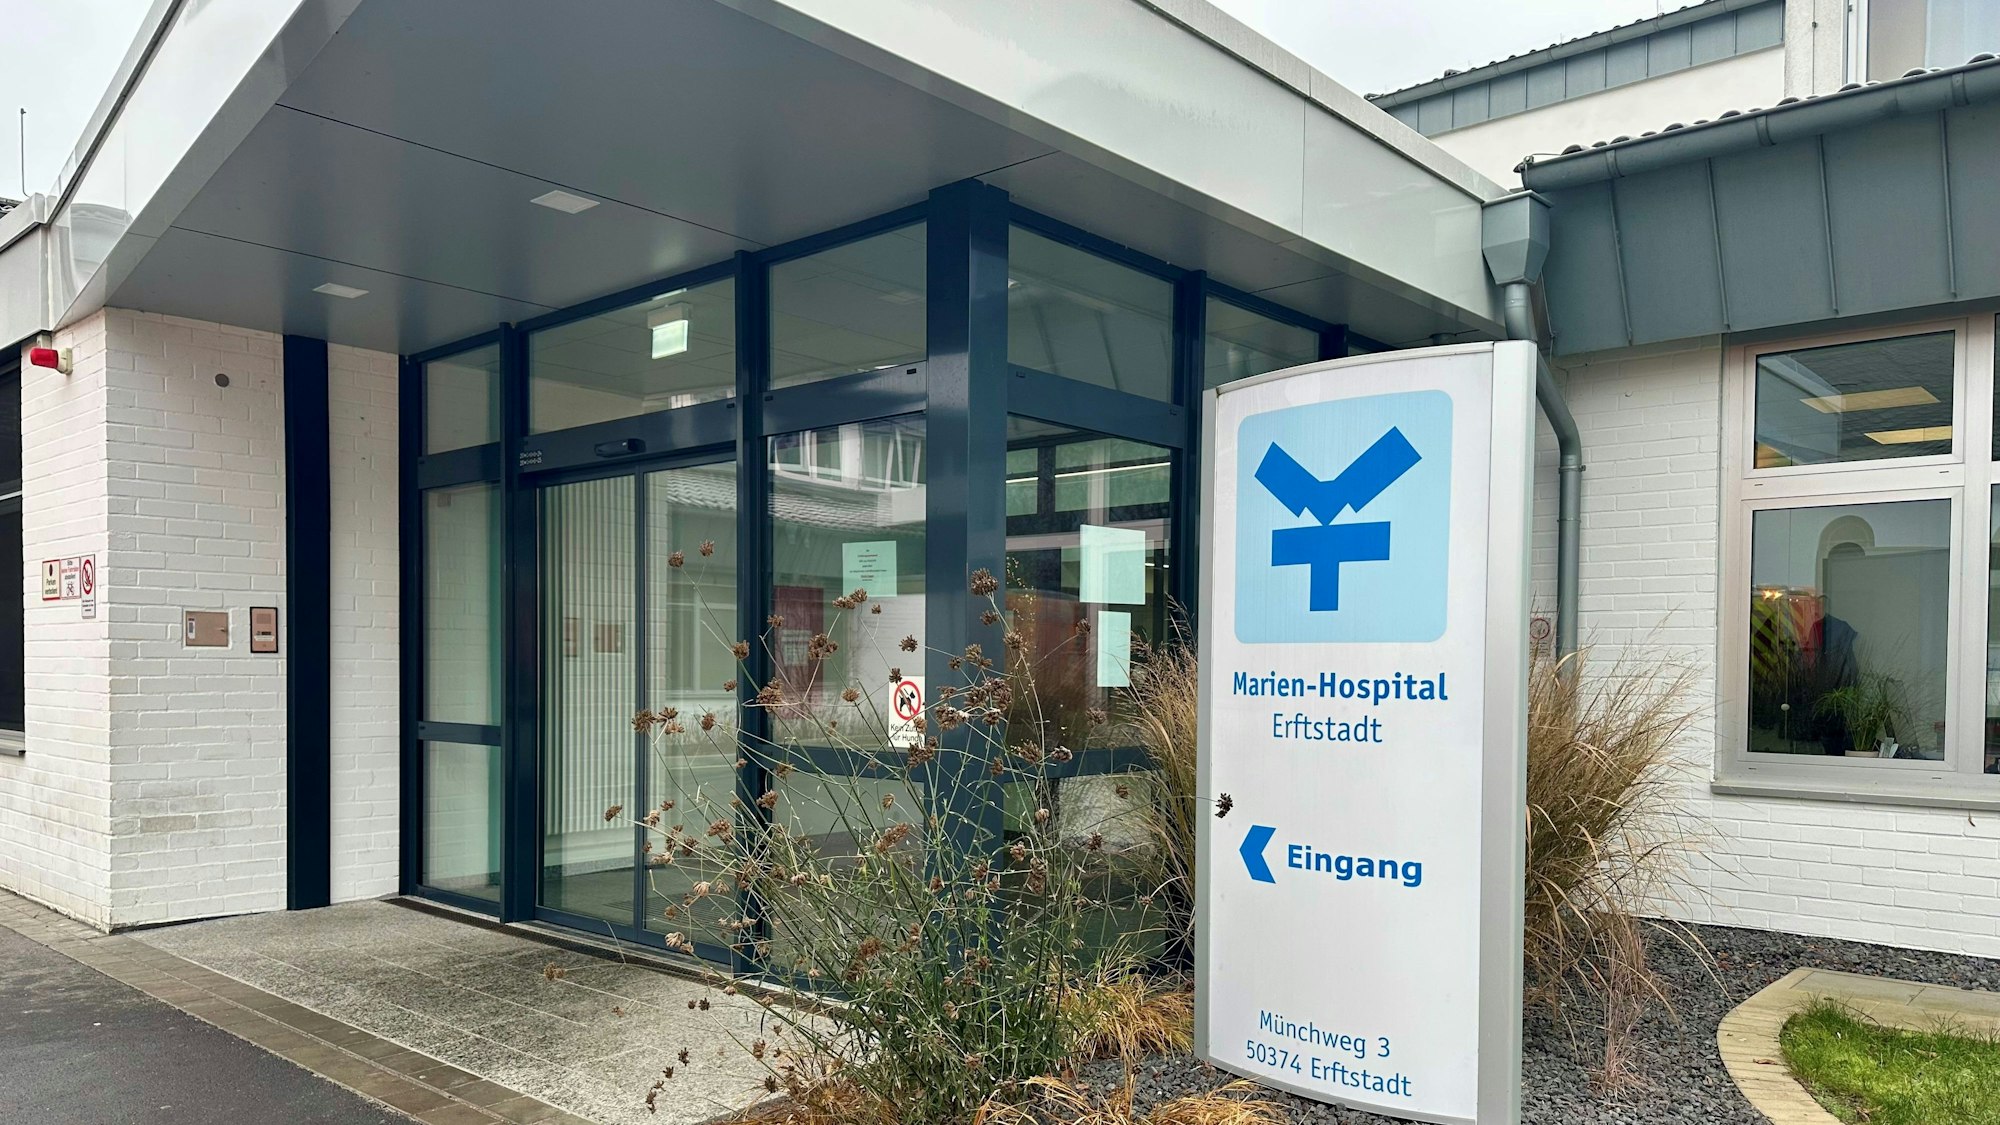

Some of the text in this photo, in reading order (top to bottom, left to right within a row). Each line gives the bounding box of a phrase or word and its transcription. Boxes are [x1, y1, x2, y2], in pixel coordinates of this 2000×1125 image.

[1232, 671, 1449, 705] Marien-Hospital
[1273, 712, 1382, 743] Erftstadt
[1287, 844, 1423, 888] Eingang
[1259, 1010, 1391, 1060] Münchweg 3
[1246, 1040, 1413, 1097] 50374 Erftstadt
